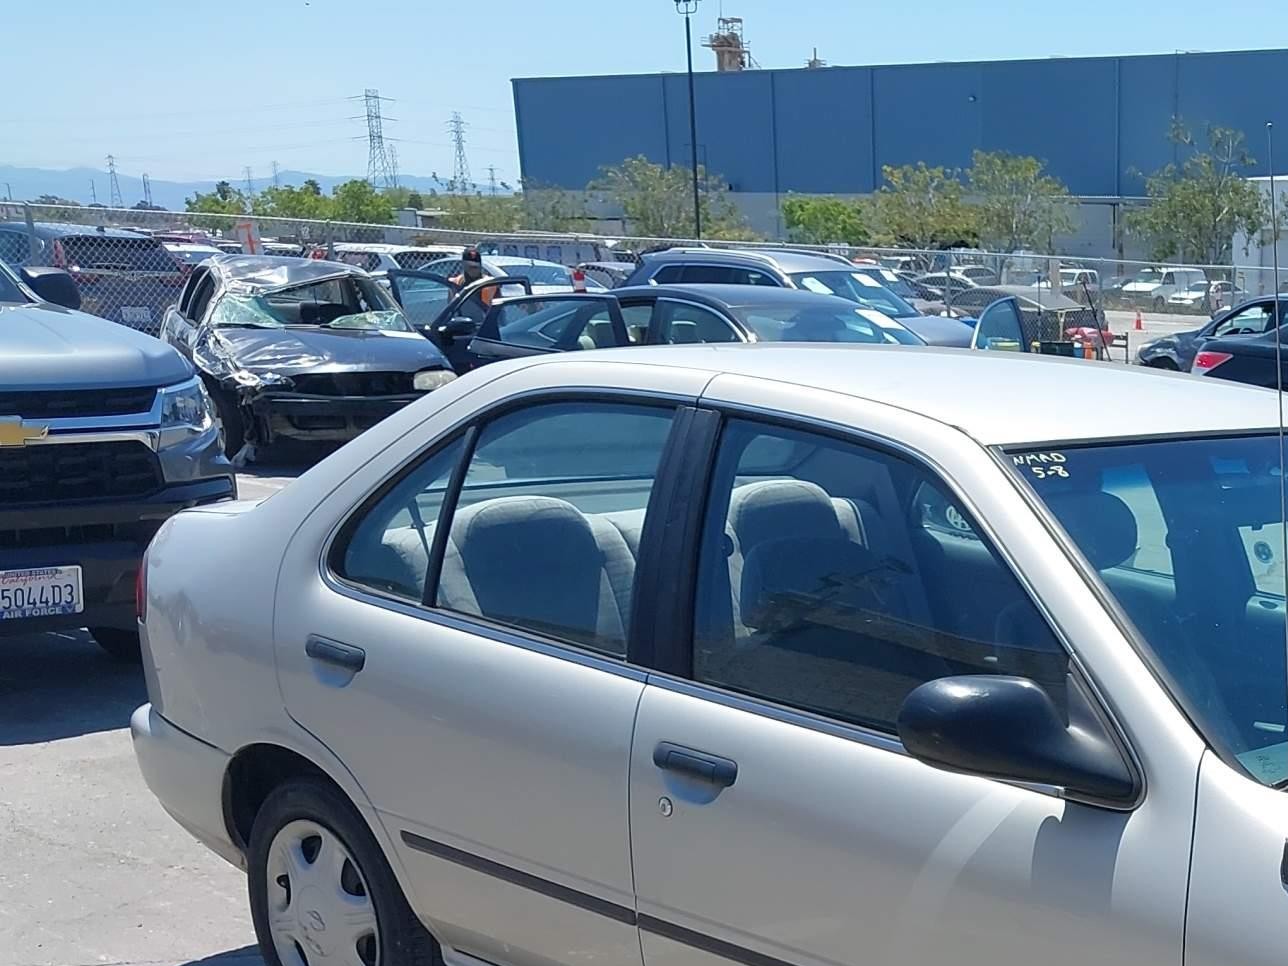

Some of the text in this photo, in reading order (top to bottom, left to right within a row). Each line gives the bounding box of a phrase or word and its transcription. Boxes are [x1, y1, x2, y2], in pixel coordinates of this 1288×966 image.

[1032, 465, 1070, 479] 5-8
[3, 606, 63, 619] AIR FORCE
